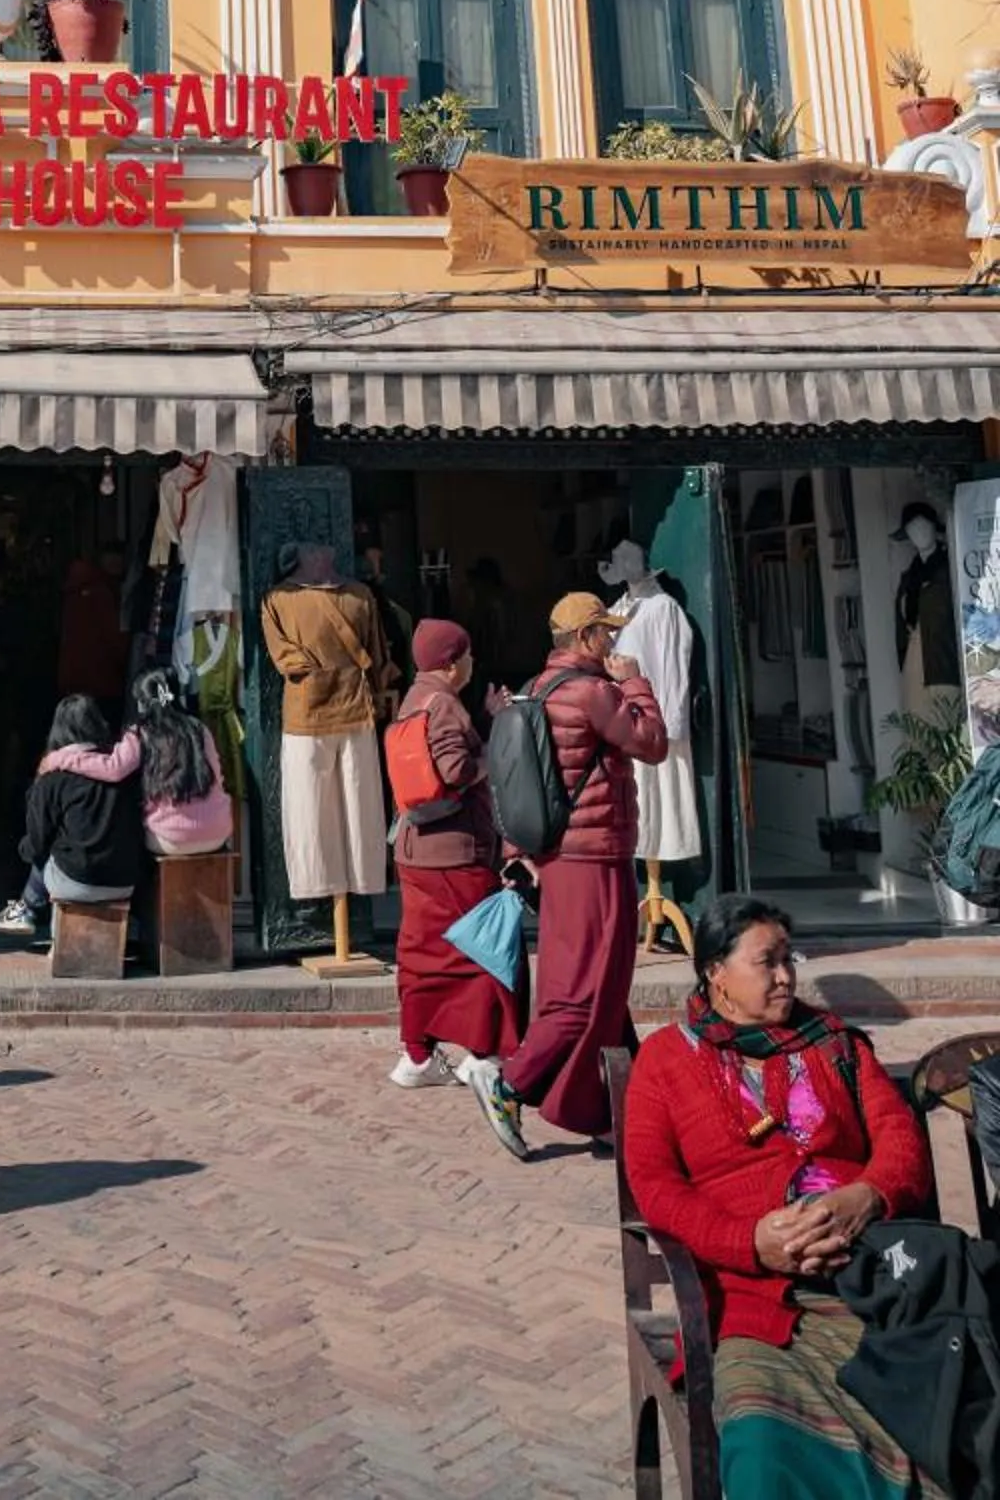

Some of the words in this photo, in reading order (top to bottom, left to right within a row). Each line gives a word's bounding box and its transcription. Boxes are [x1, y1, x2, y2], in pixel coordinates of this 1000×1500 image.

[29, 71, 409, 143] RESTAURANT
[525, 185, 866, 231] RIMTHIM
[548, 238, 649, 251] SUSTAINABLY
[659, 238, 769, 251] HANDCRAFTED
[778, 238, 793, 250] IN
[803, 238, 848, 250] NEPAL
